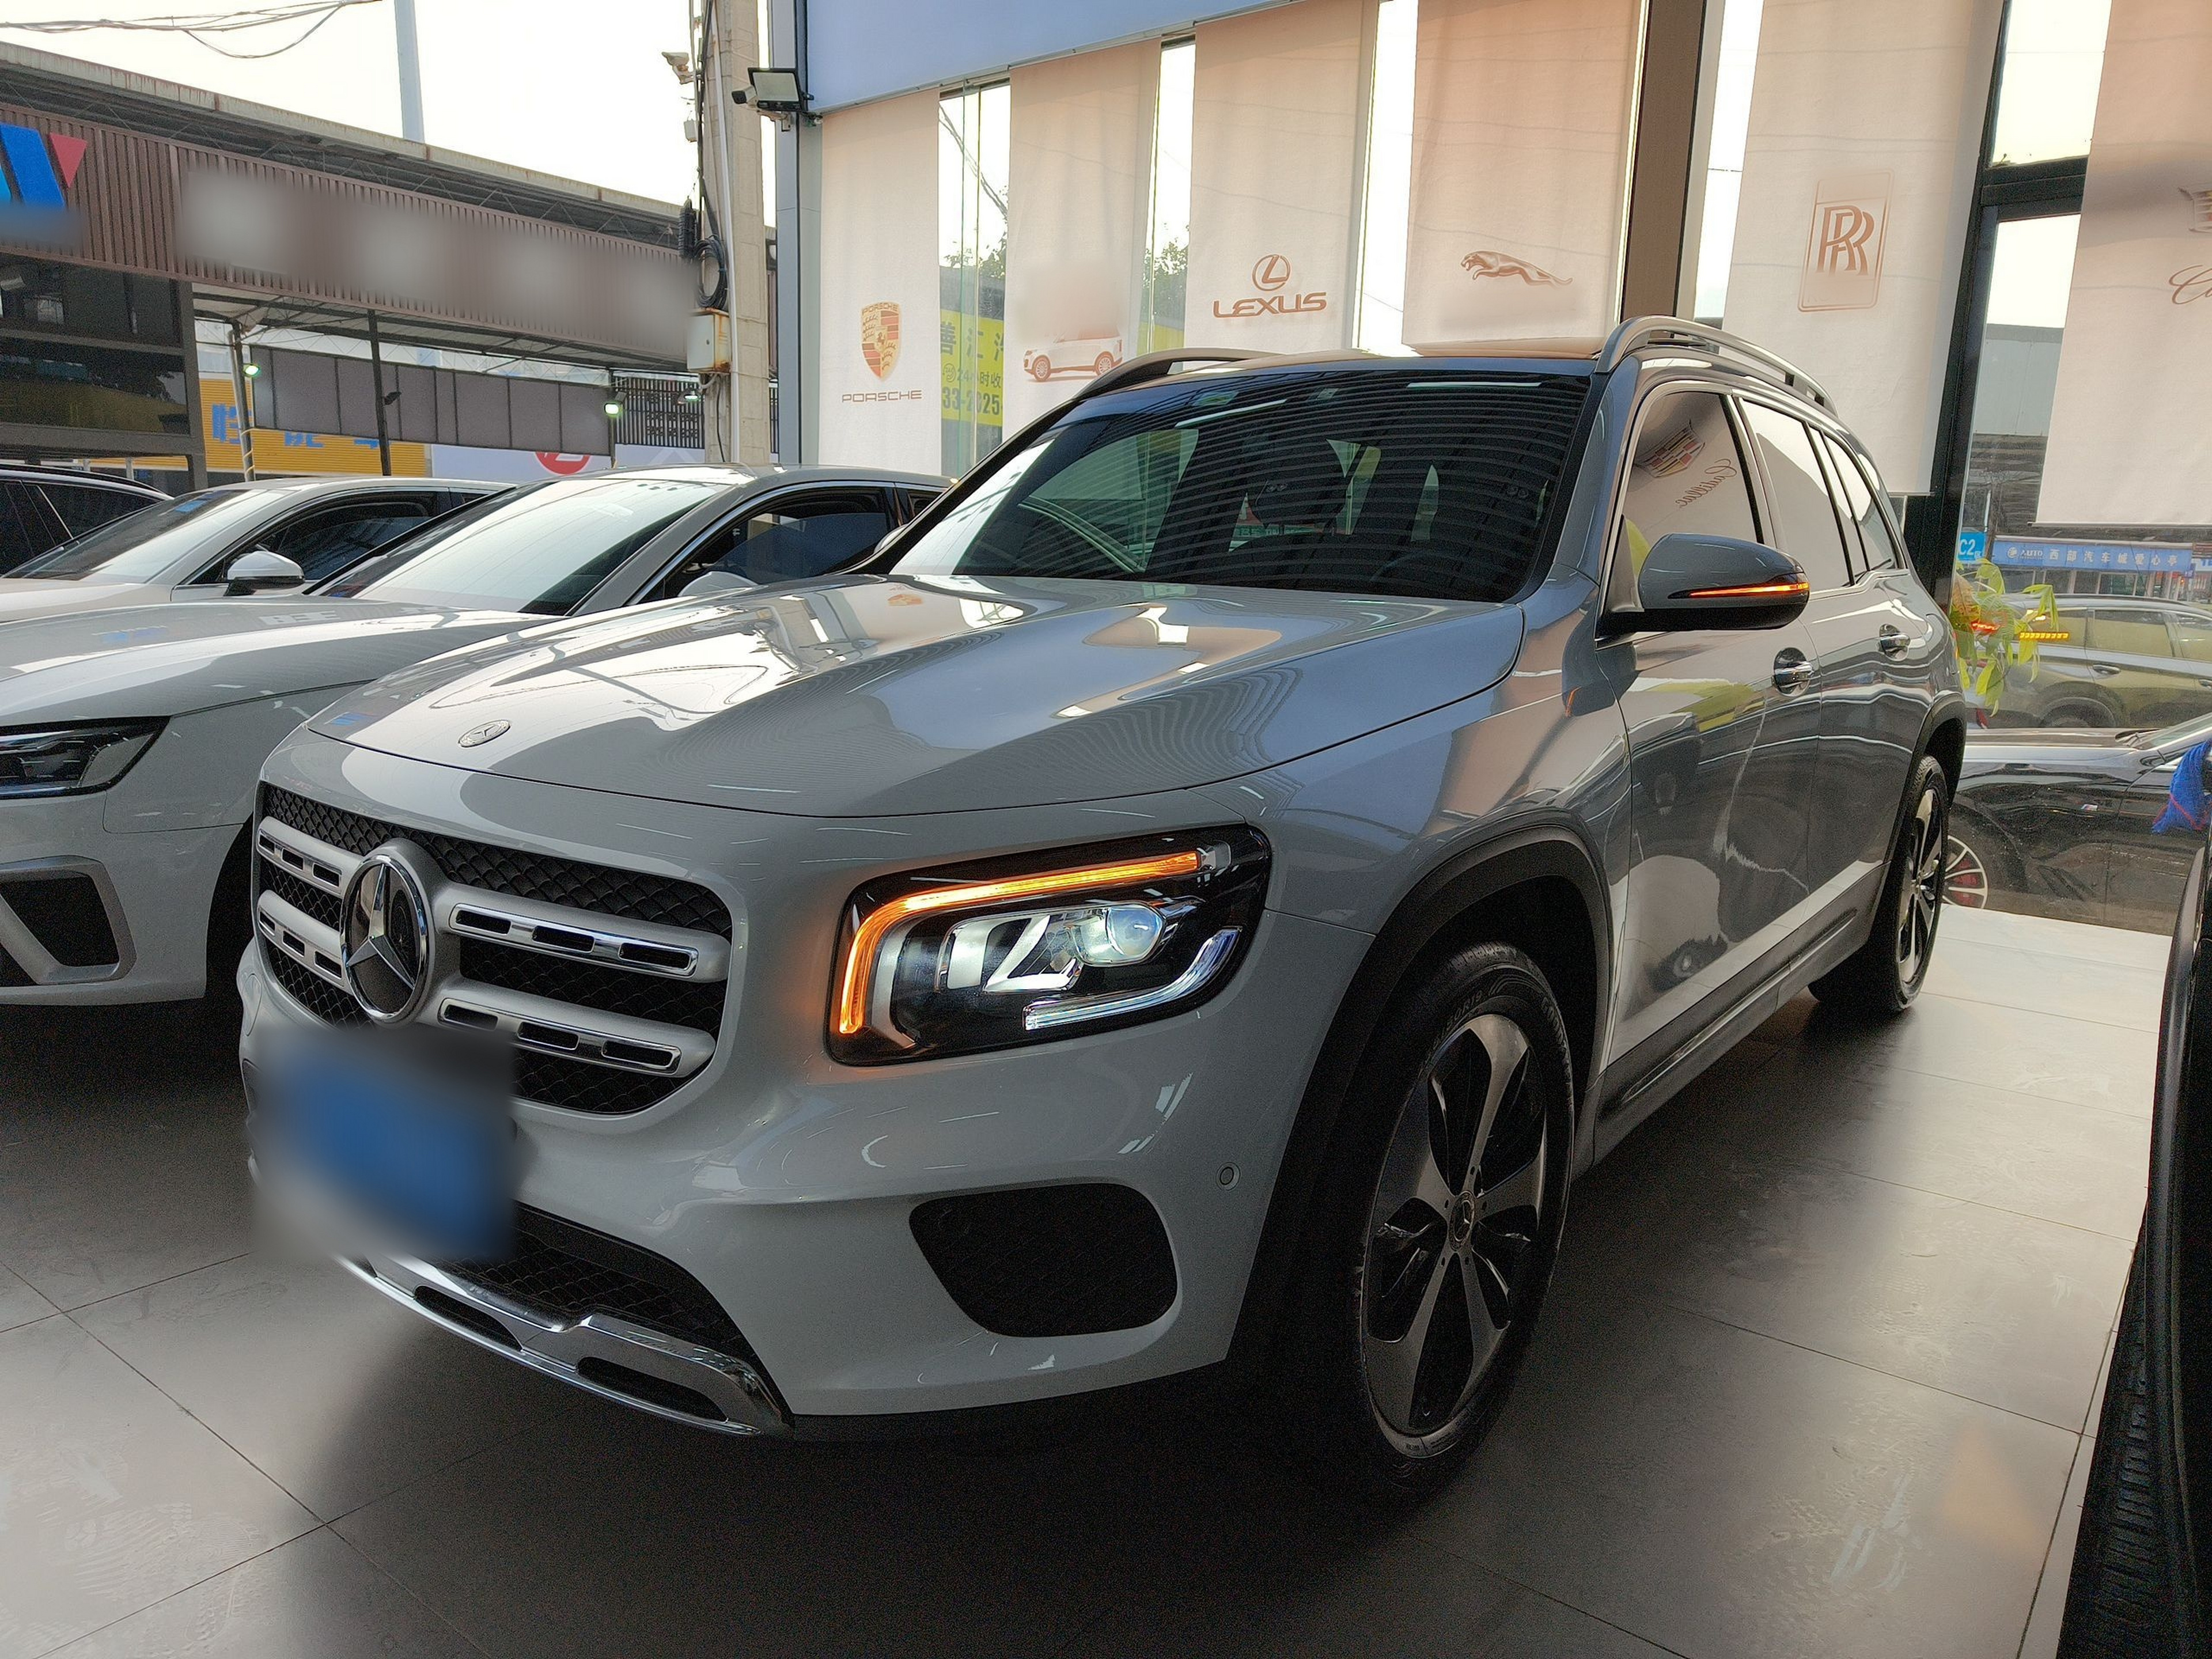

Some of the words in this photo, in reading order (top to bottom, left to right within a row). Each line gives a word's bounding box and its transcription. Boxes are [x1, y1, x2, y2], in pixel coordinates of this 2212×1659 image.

[862, 302, 899, 316] PORSCHE
[1213, 292, 1327, 318] LEXUS
[842, 389, 922, 403] PORSCHE
